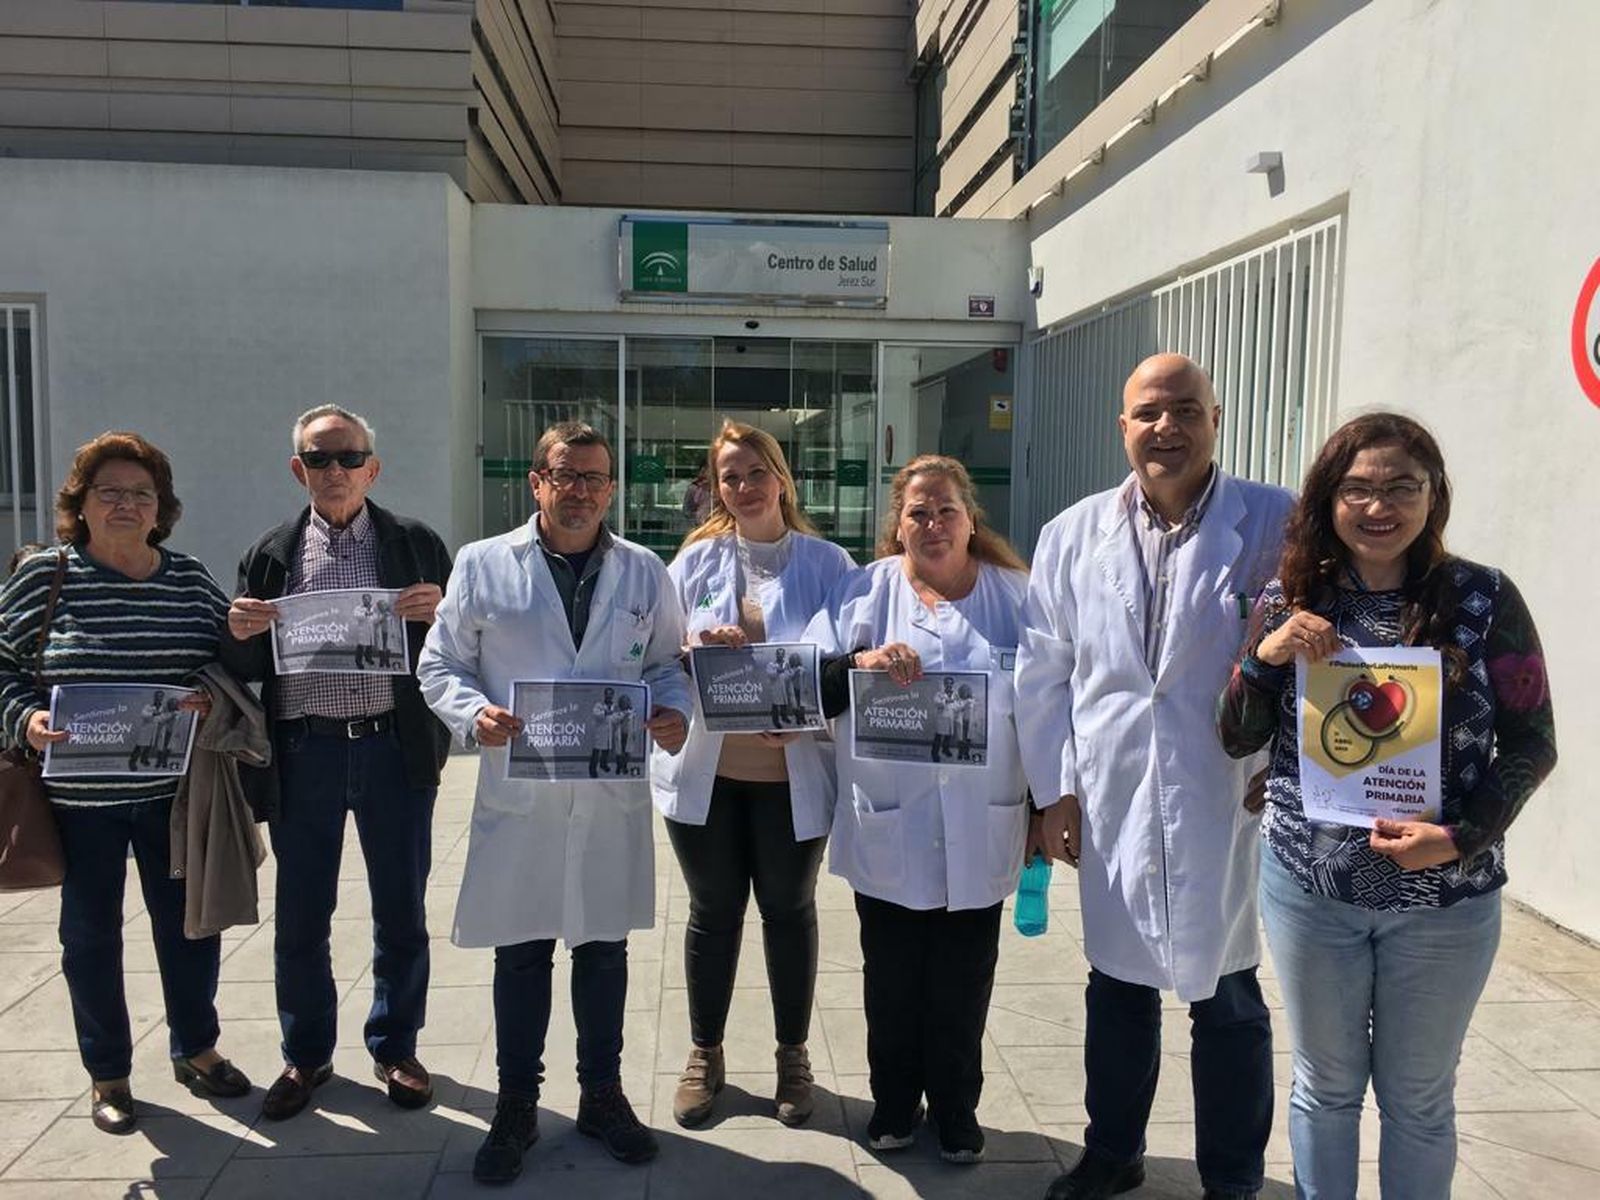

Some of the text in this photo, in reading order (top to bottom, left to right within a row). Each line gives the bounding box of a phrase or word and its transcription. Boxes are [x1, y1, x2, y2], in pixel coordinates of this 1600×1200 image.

[767, 253, 877, 271] Centro de Salud
[837, 275, 859, 287] Jerez
[285, 621, 349, 638] ATENCIÓN
[291, 633, 345, 646] PRIMARIA
[707, 680, 763, 694] ATENCIÓN
[713, 694, 761, 704] PRIMARIA
[864, 707, 928, 721] ATENCIÓN
[65, 719, 133, 733] ATENCIÓN
[522, 721, 586, 735] ATENCIÓN
[869, 717, 924, 731] PRIMARIA
[69, 733, 125, 745] PRIMARIA
[527, 735, 580, 747] PRIMARIA
[1378, 764, 1426, 777] DÍA DE LA
[1363, 776, 1426, 790] ATENCIÓN
[1365, 790, 1425, 804] PRIMARIA
